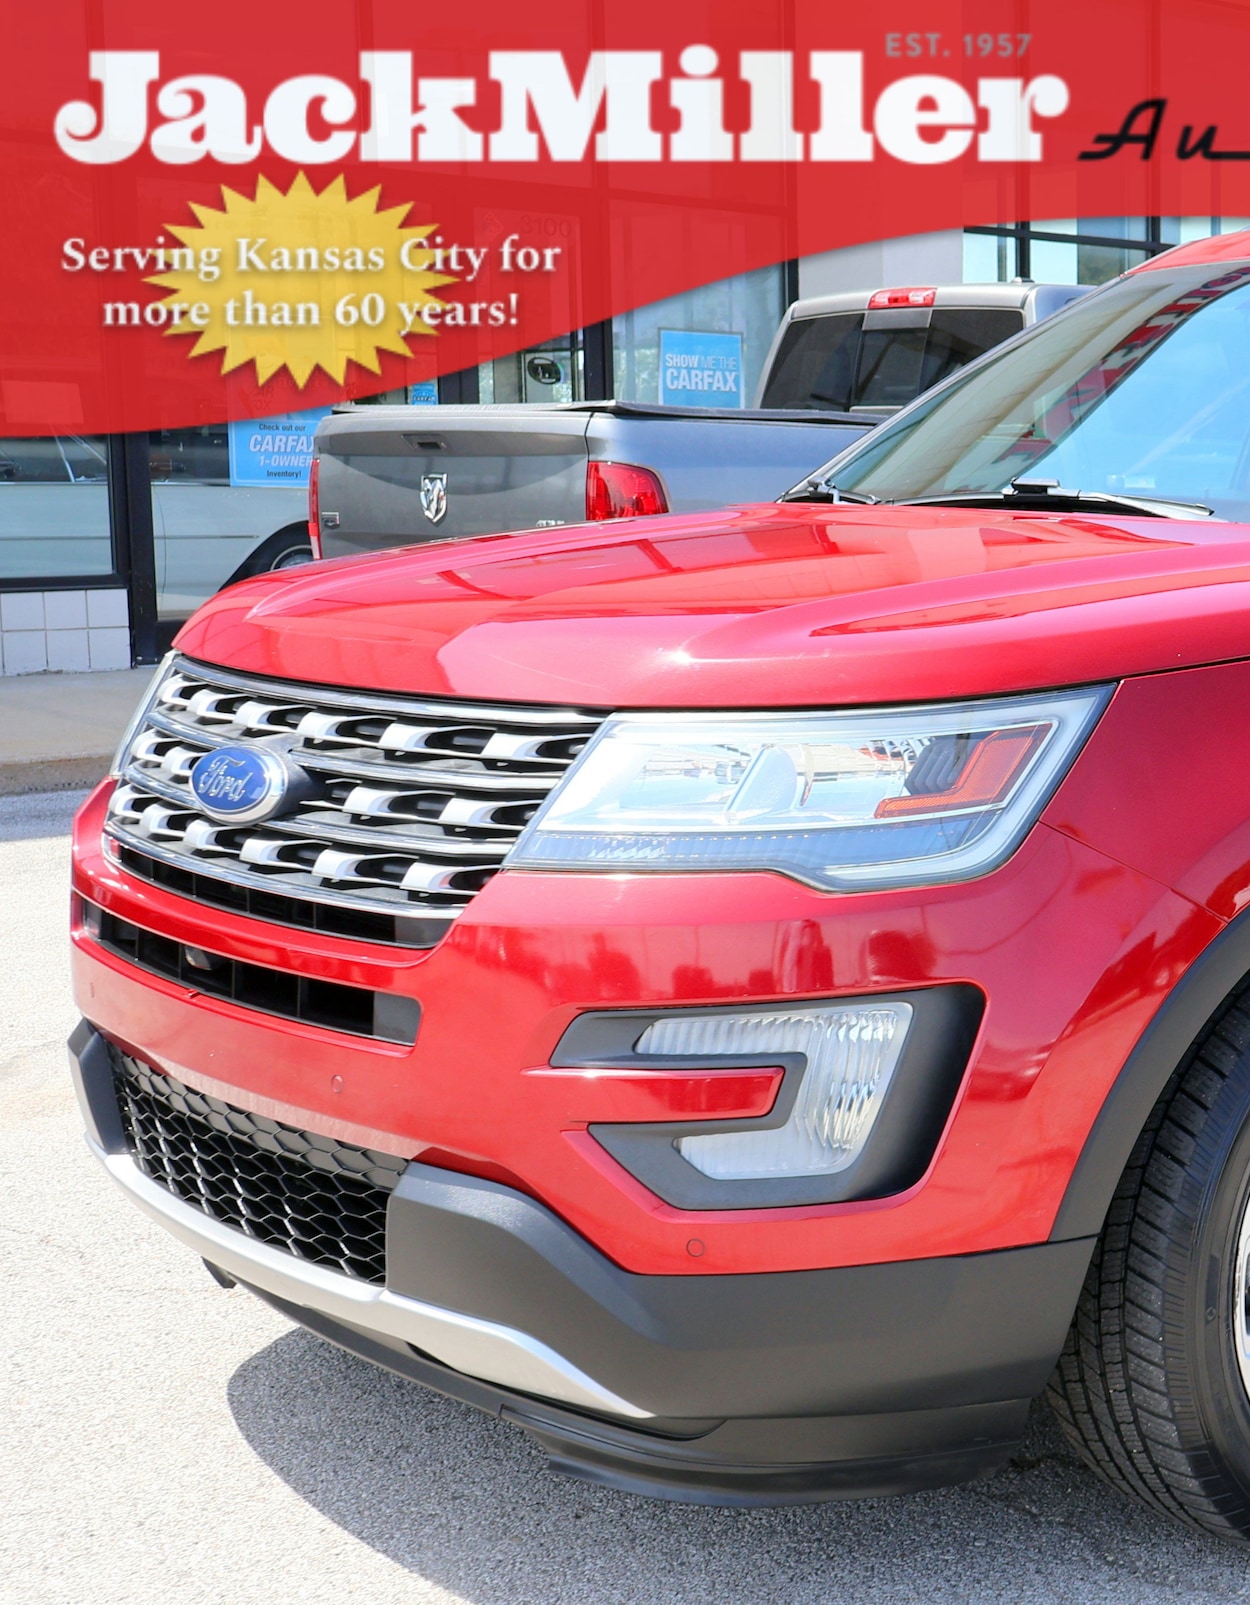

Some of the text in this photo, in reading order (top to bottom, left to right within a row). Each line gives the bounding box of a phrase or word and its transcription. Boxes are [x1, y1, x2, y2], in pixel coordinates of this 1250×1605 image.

[665, 353, 699, 368] SHOW
[665, 368, 737, 392] CARFAX
[259, 423, 306, 432] Check out our
[266, 470, 302, 479] Inventory!
[199, 754, 253, 802] Ford
